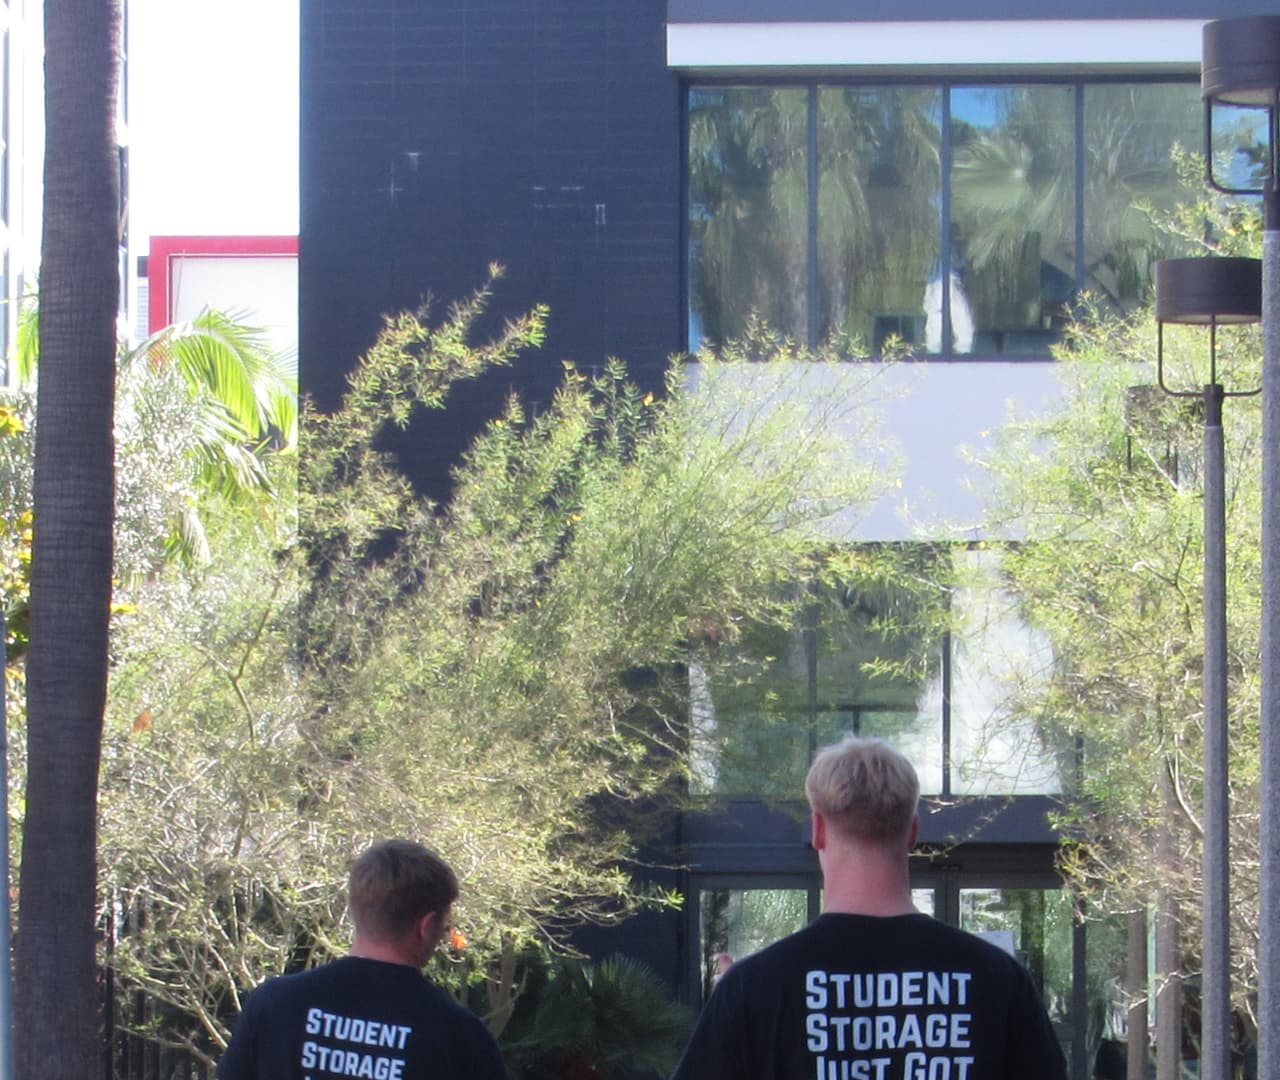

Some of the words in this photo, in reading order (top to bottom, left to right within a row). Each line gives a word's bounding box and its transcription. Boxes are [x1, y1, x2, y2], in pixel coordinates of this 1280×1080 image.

[805, 970, 972, 1010] STUDENT
[306, 1007, 412, 1050] STUDENT
[805, 1013, 972, 1052] STORAGE
